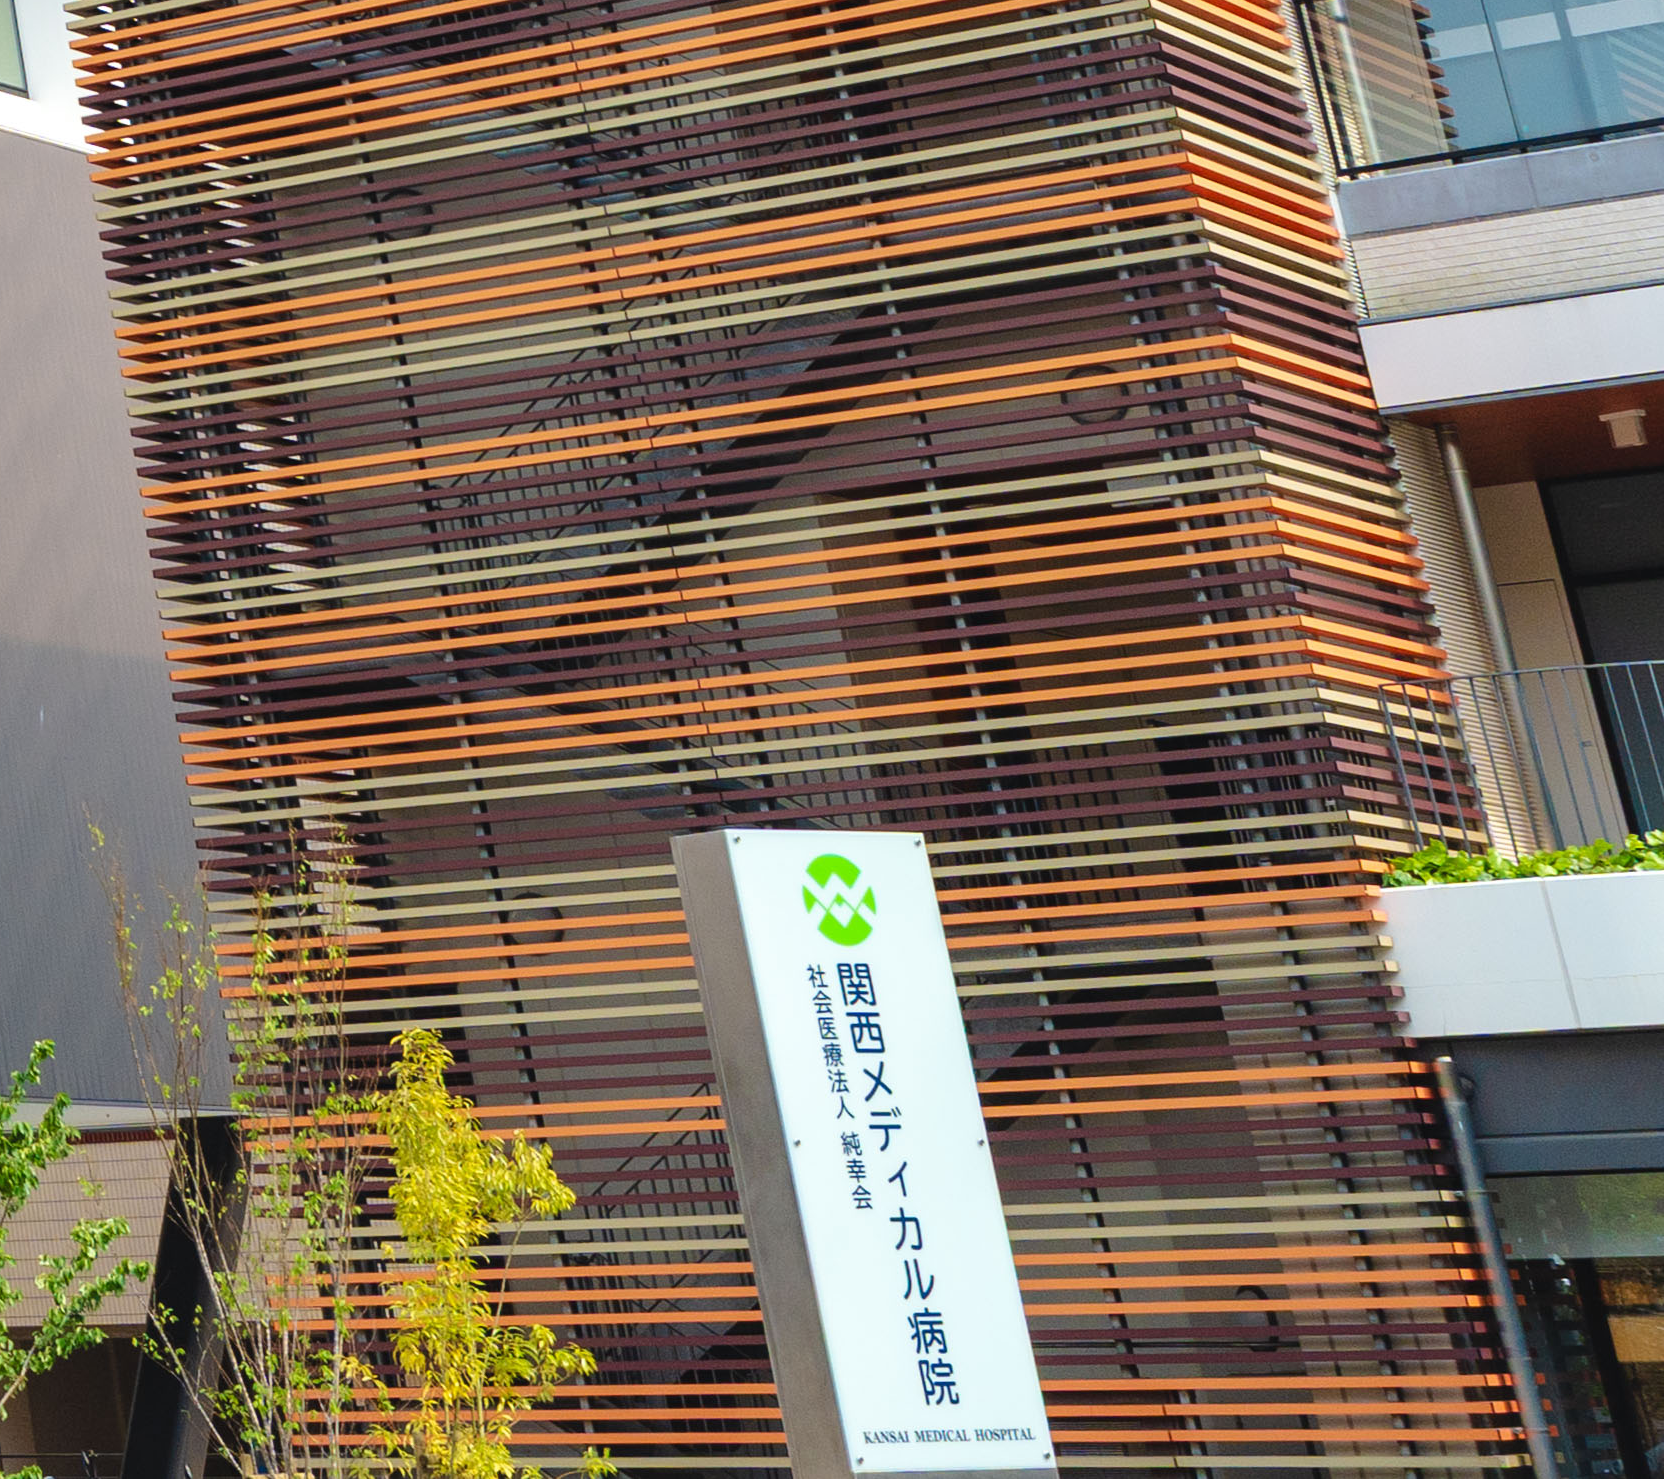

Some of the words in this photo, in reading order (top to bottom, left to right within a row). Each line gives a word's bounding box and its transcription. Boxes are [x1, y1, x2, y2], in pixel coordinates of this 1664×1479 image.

[807, 963, 856, 1120] 社会医療法人
[840, 1130, 874, 1211] 純幸会
[836, 962, 960, 1407] 関西メディカル病院
[862, 1430, 911, 1445] KANSAI
[914, 1429, 971, 1443] MEDICAL
[974, 1427, 1037, 1442] HOSPITAL
